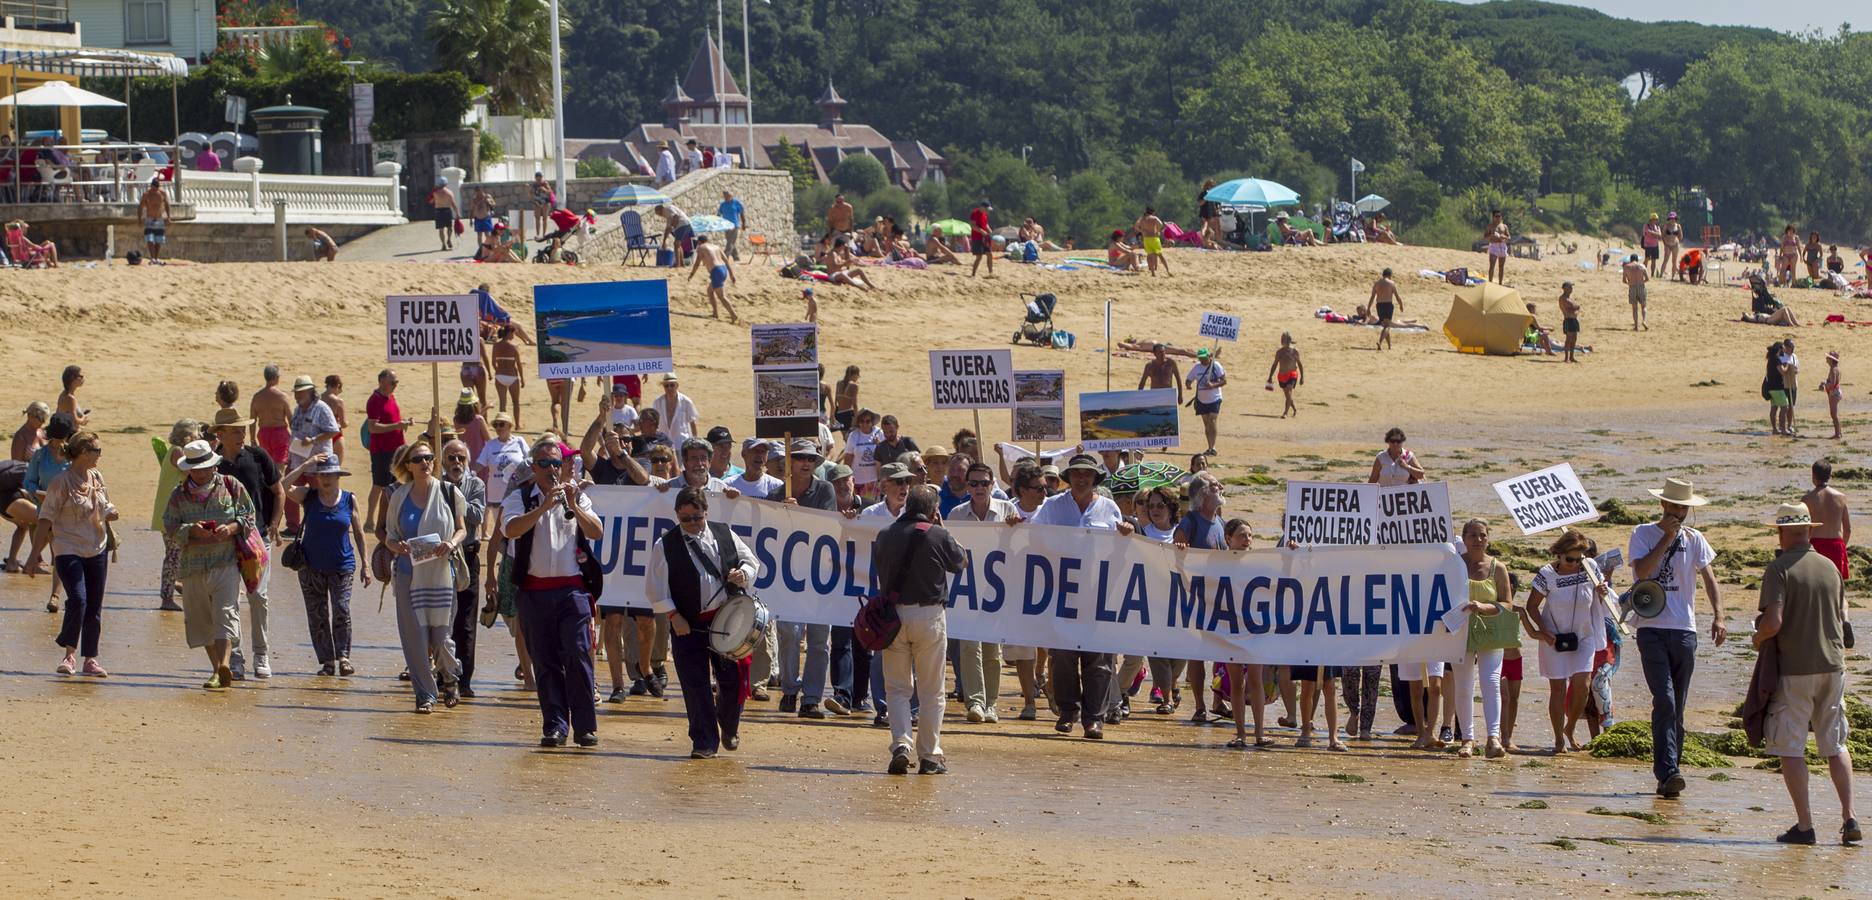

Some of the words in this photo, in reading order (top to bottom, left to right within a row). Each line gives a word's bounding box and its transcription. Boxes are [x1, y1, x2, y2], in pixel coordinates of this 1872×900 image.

[400, 300, 460, 324] FUERA
[1207, 314, 1232, 327] FUERA
[390, 328, 473, 356] ESCOLLERAS
[1201, 323, 1236, 339] ESCOLLERAS
[549, 365, 569, 376] Viva
[571, 364, 582, 374] La
[584, 362, 635, 375] Magdalena
[637, 361, 663, 371] LIBRE
[942, 355, 997, 376] FUERA
[935, 379, 1010, 404] ESCOLLERAS
[1089, 441, 1098, 449] La
[1300, 487, 1361, 513] FUERA
[1508, 472, 1567, 503] FUERA
[1378, 490, 1433, 517] UERA
[1513, 490, 1590, 529] ESCOLLERAS
[1289, 515, 1371, 545] ESCOLLERAS
[1377, 515, 1448, 545] COLLERAS
[1022, 554, 1082, 619] DE
[1095, 560, 1151, 625] LA
[1167, 571, 1454, 635] MAGDALENA
